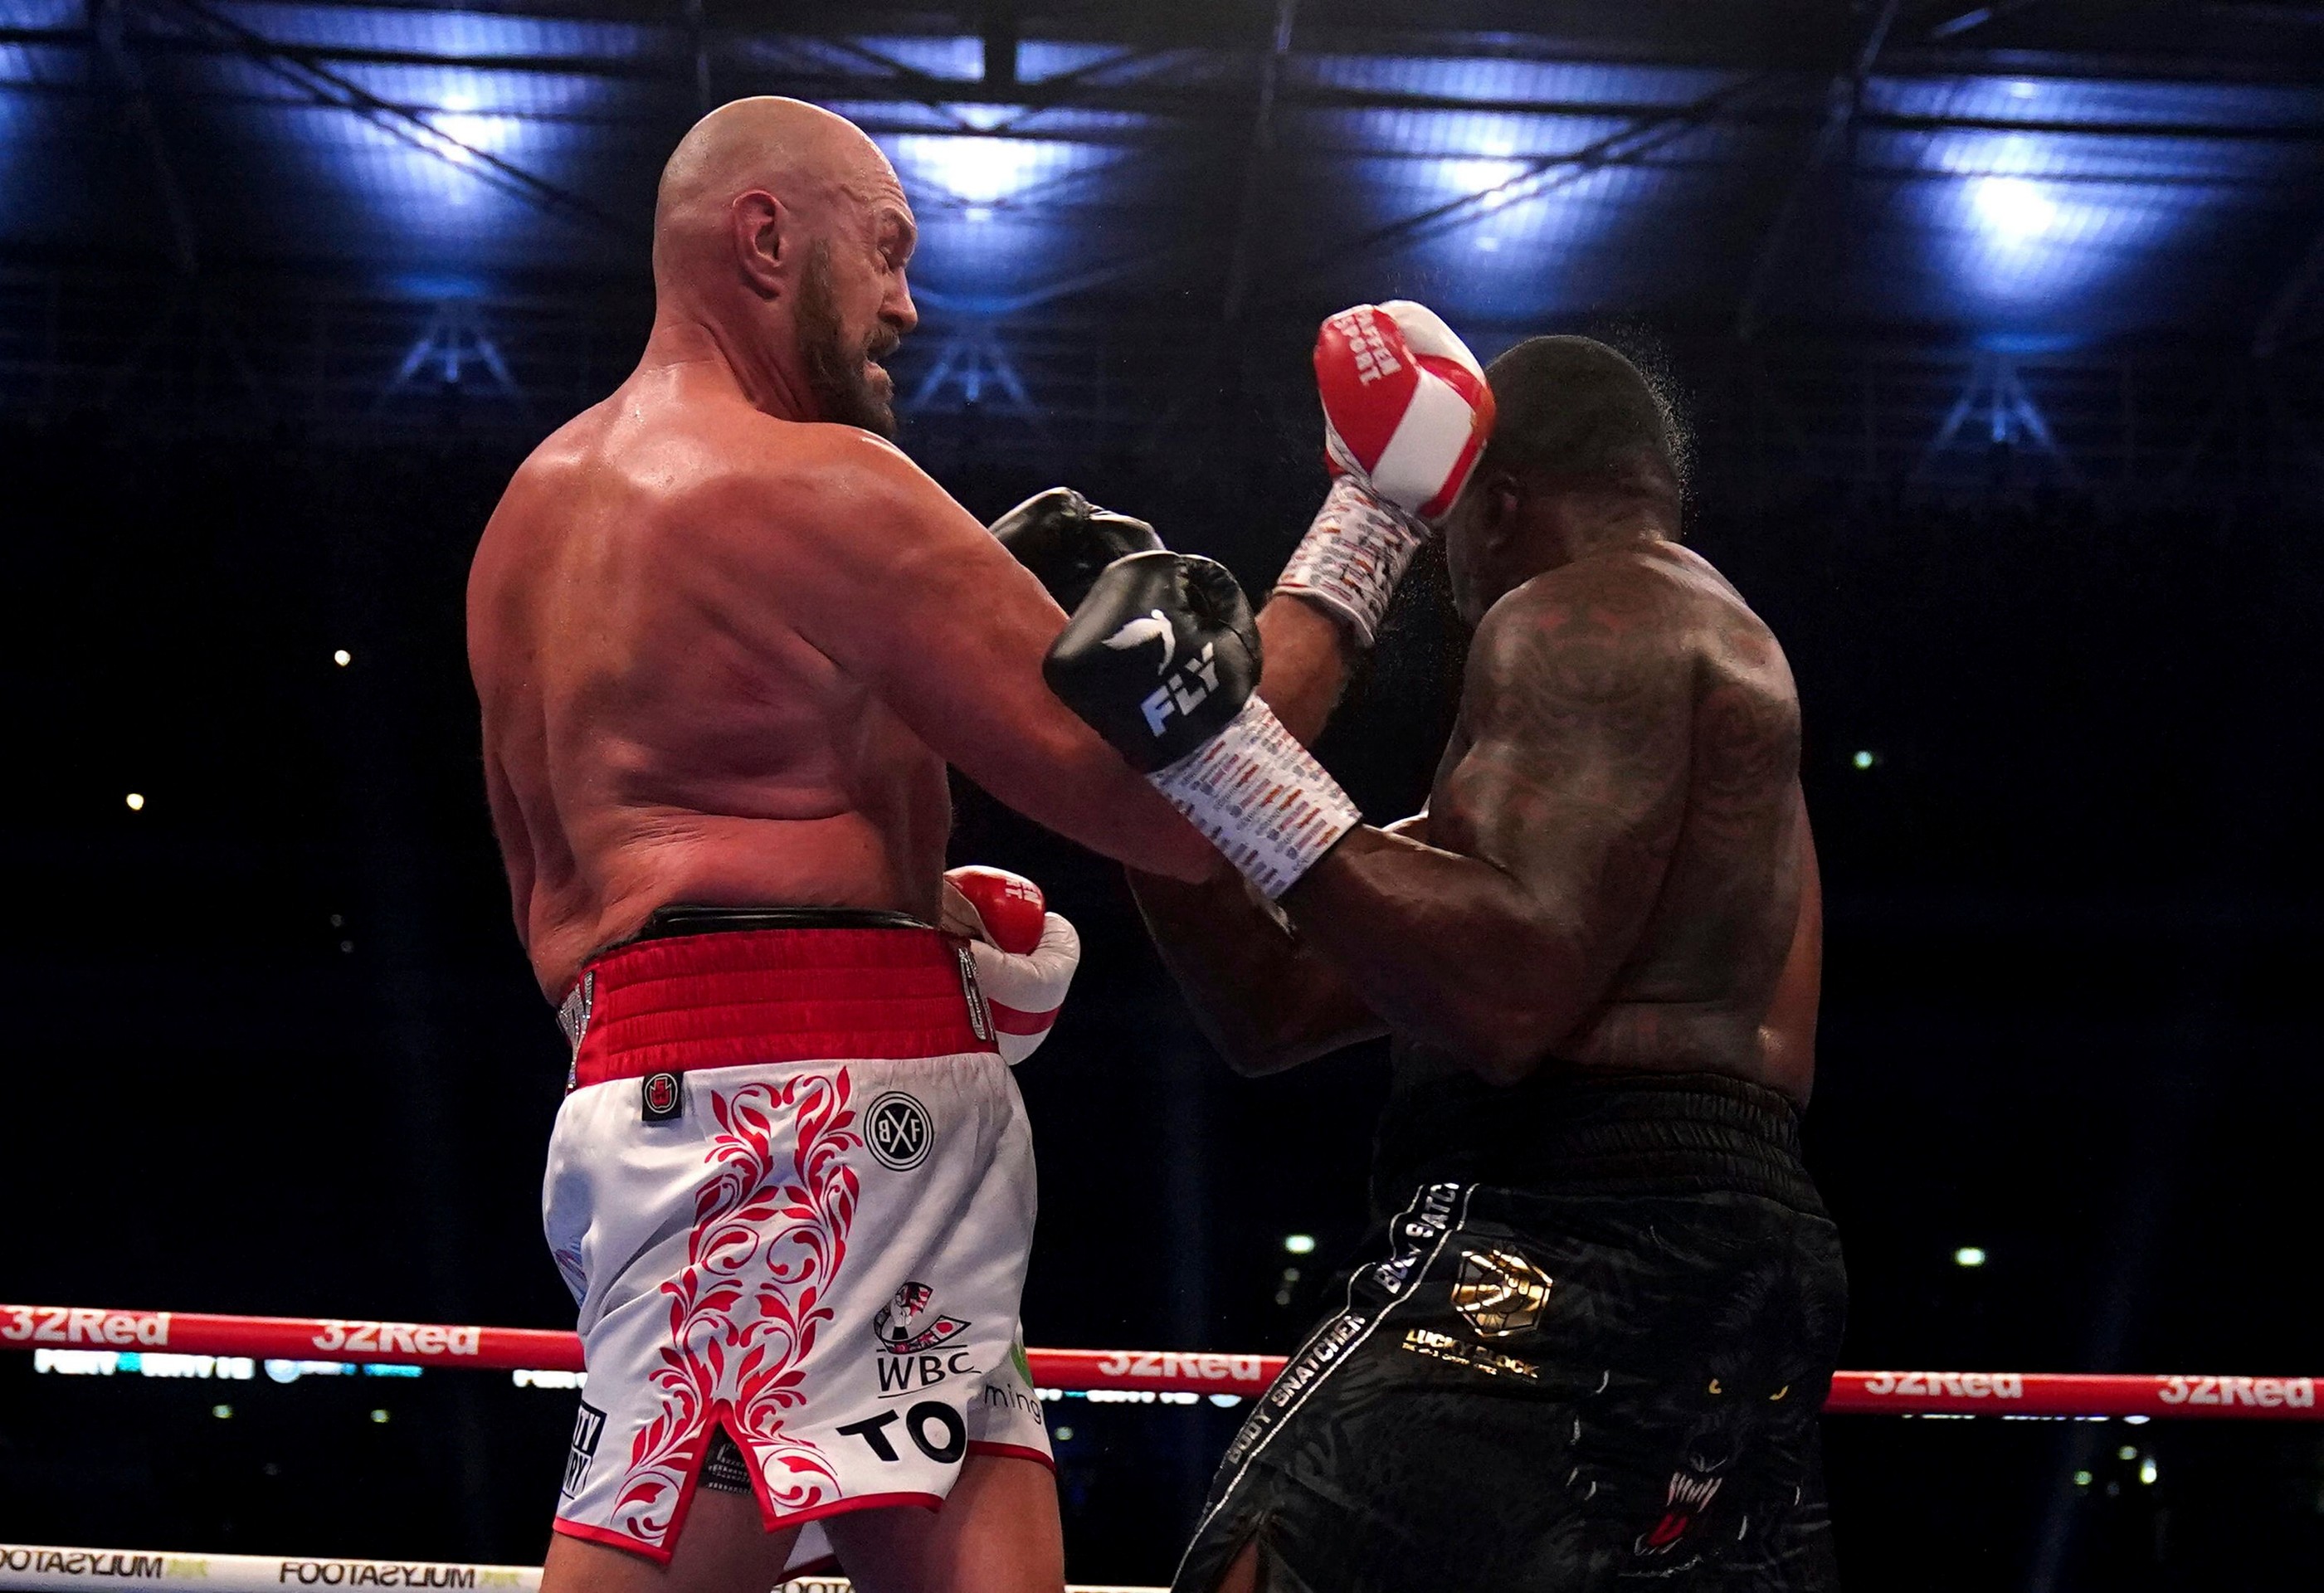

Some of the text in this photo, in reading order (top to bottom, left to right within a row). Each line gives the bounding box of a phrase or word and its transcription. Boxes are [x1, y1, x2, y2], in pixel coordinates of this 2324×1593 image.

[1139, 641, 1220, 738] FLY
[1, 1305, 172, 1346] 32Red
[312, 1319, 481, 1355] 32Red
[877, 1352, 975, 1392] WBC
[2156, 1375, 2315, 1408] 32Red
[1227, 1407, 1272, 1464] BODY
